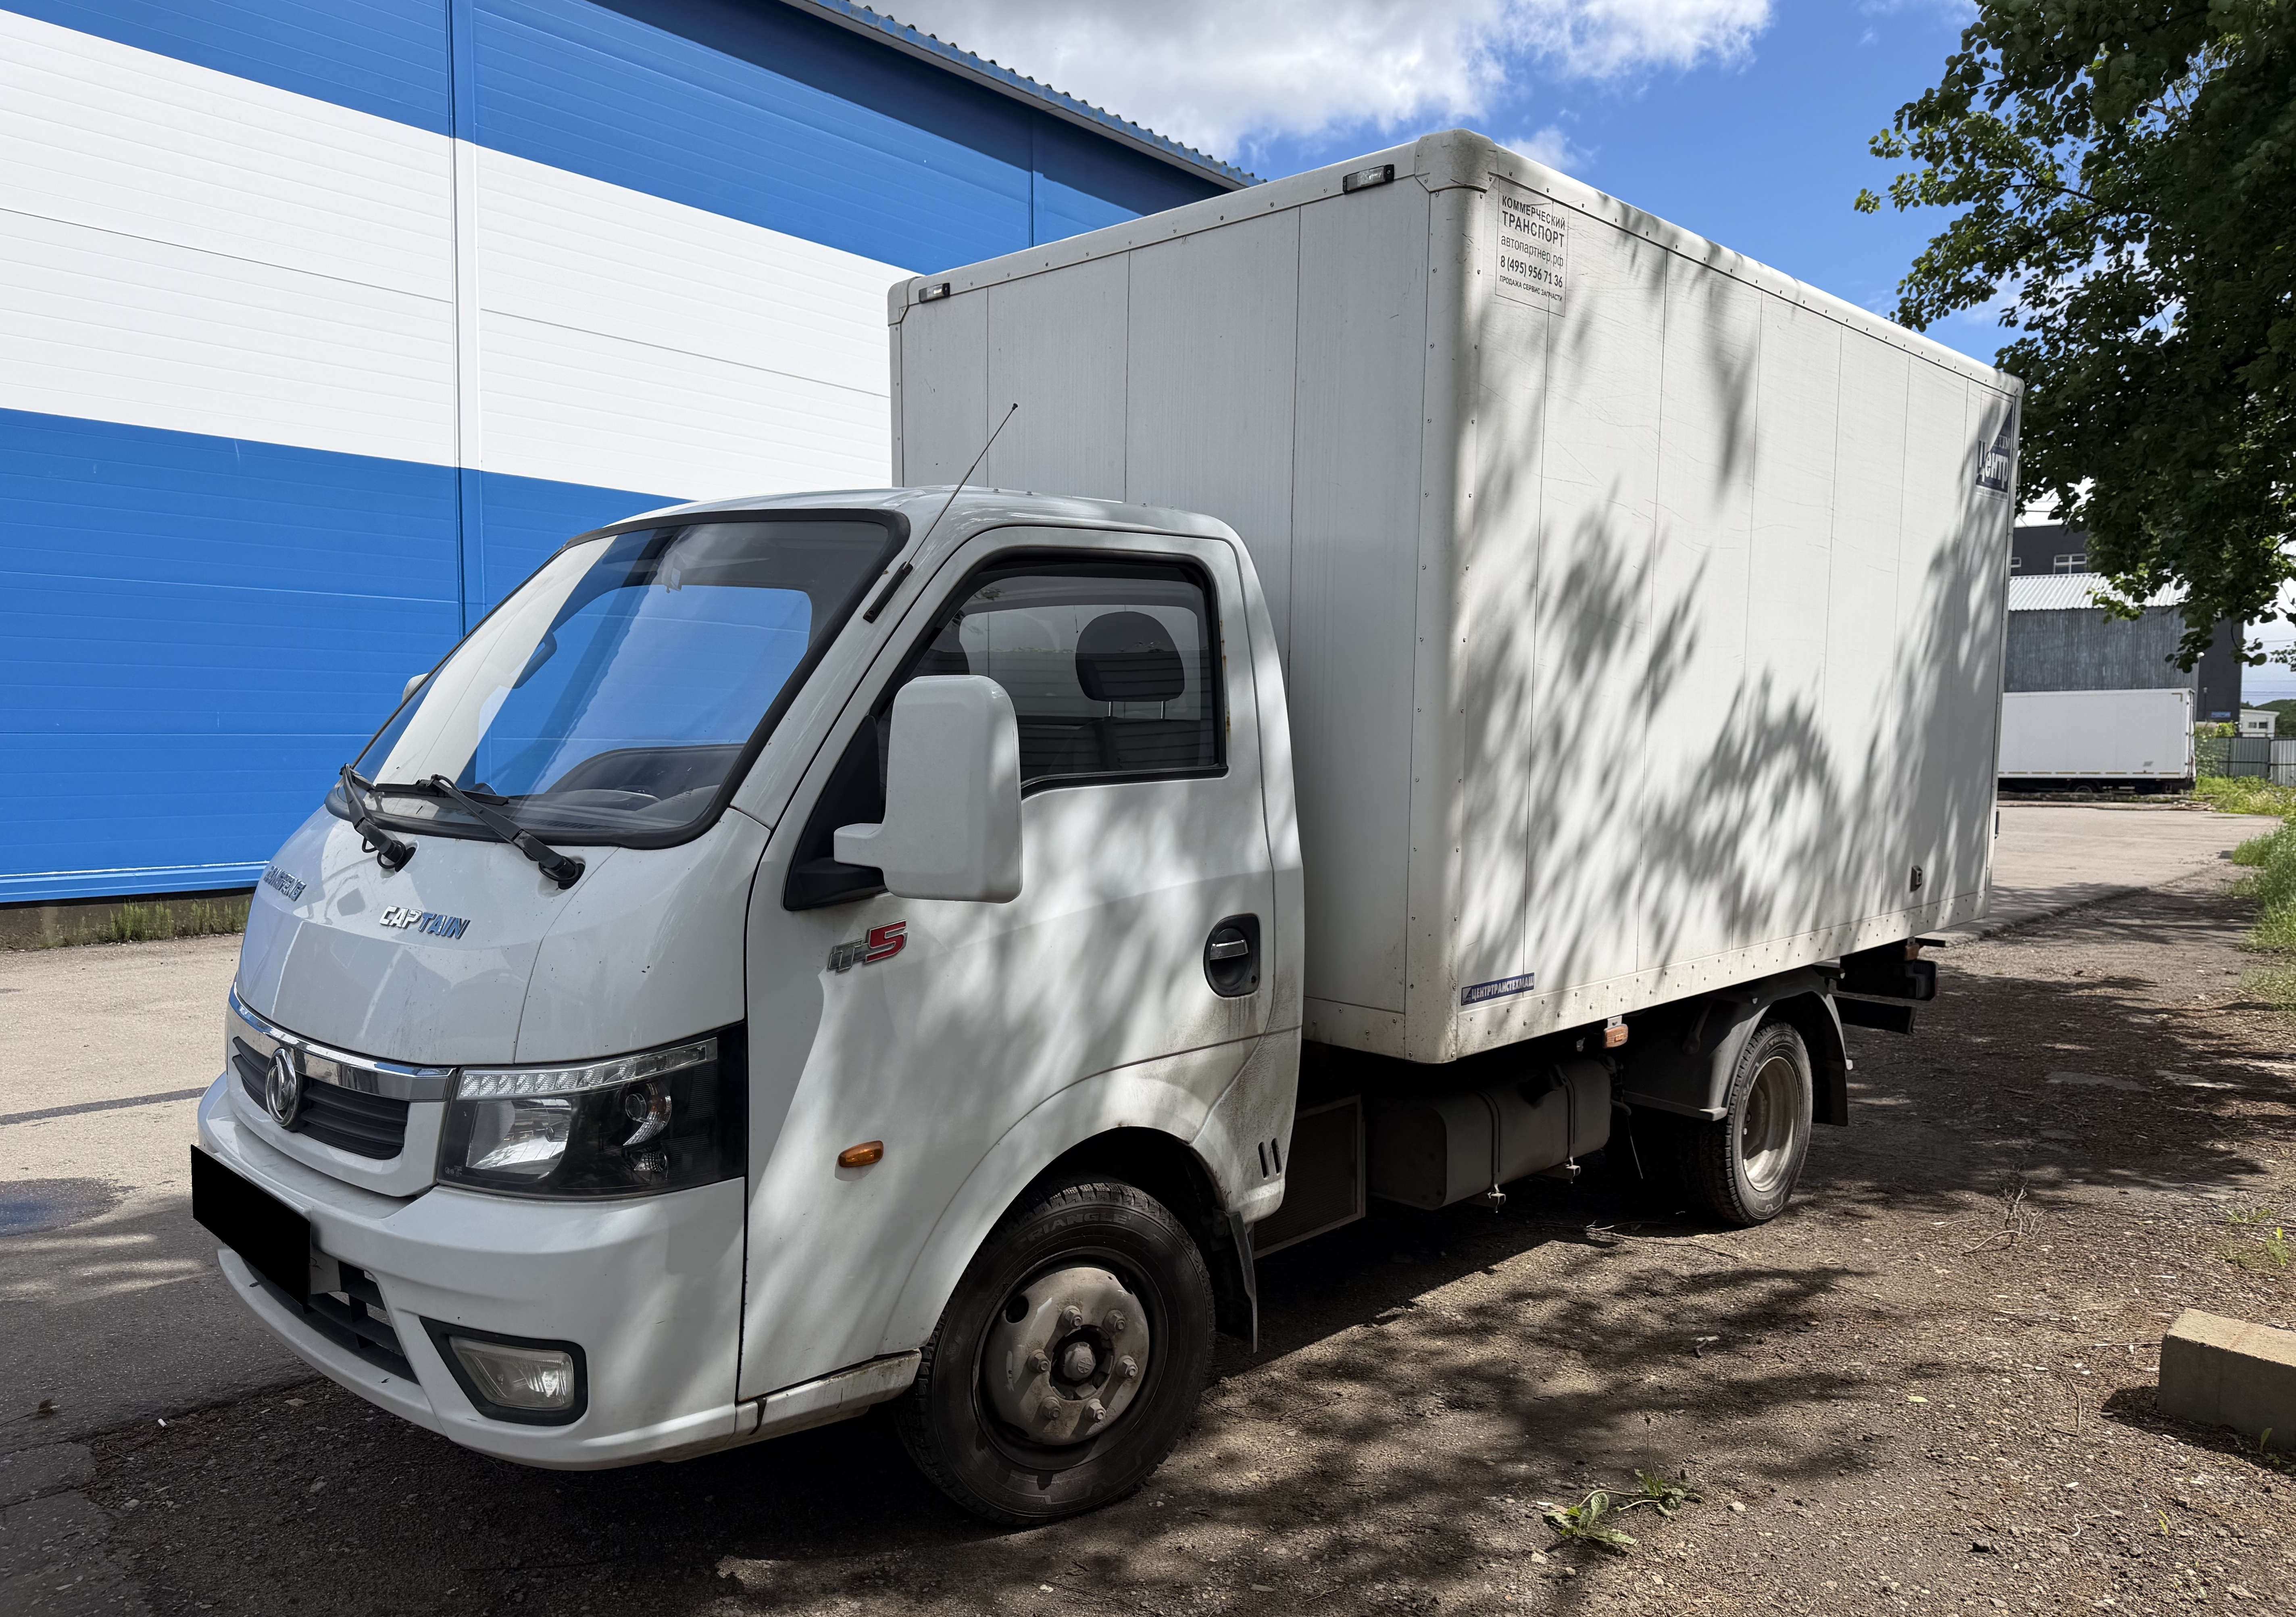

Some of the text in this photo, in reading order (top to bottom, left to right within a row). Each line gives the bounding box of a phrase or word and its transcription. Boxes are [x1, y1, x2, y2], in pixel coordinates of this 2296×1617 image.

[1502, 195, 1565, 230] КОММЕРЧЕСКИЙ
[1502, 210, 1565, 247] ТРАНСПОРТ
[1501, 236, 1563, 269] автопартнер.рф
[1500, 255, 1563, 288] 8 (495) 956 71 36
[1500, 275, 1563, 301] ПРОДАЖА СЕРВИС ЗАПЧАСТИ
[379, 905, 471, 940] CAPTAIN
[1471, 975, 1534, 1001] ЦЕНТРТРАНСТЕХМАШ
[1014, 1212, 1127, 1250] TRIANGLE
